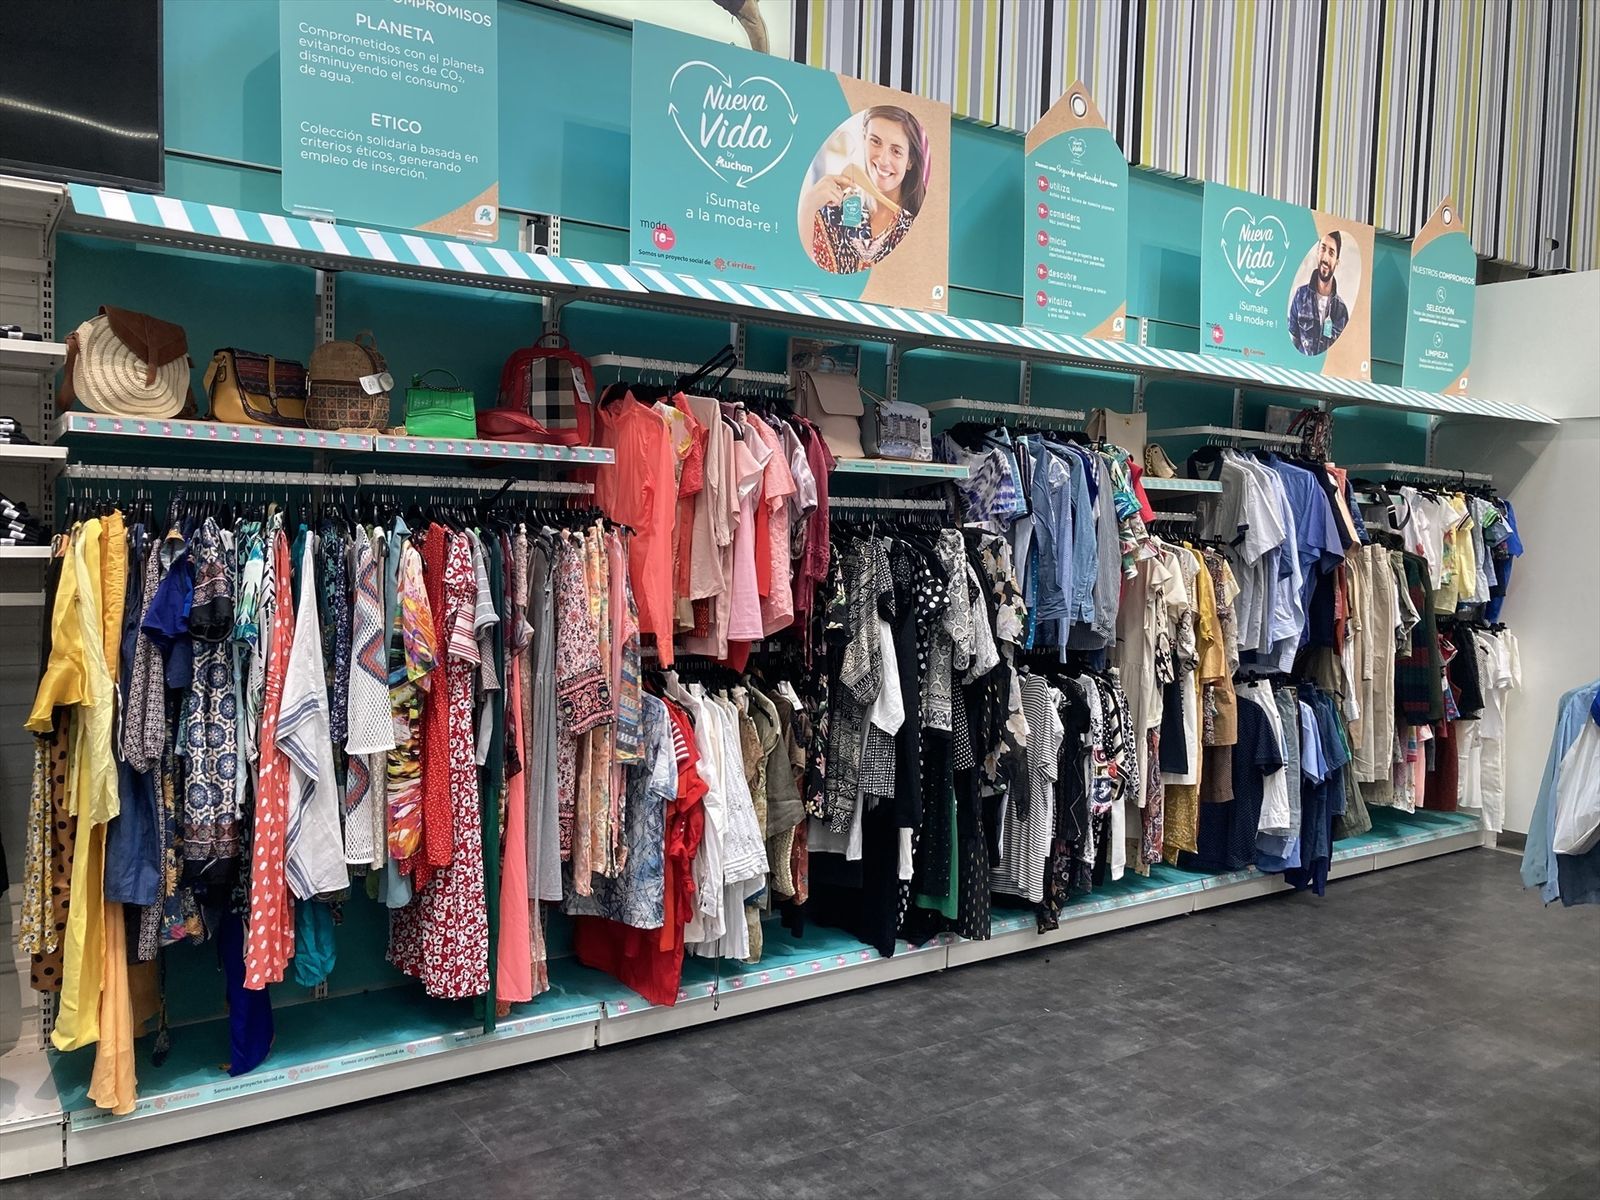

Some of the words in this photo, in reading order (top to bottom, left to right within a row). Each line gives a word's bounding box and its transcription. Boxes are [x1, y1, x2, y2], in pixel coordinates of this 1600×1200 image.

[393, 0, 492, 27] MPROMISOS
[356, 13, 434, 44] PLANETA
[299, 22, 400, 54] Comprometidos
[404, 48, 426, 60] con
[429, 54, 439, 63] el
[442, 56, 484, 75] planeta
[299, 37, 355, 57] evitando
[359, 51, 419, 72] emisiones
[422, 64, 437, 76] de
[299, 50, 388, 78] disminuyendo
[391, 71, 401, 81] el
[405, 74, 458, 94] consumo
[299, 63, 316, 76] de
[320, 68, 355, 84] agua.
[703, 84, 768, 111] Nueva
[371, 112, 422, 135] ETICO
[700, 112, 772, 148] Vida
[300, 120, 363, 143] Colección
[366, 134, 417, 153] solidaria
[421, 143, 461, 161] basada
[464, 153, 479, 163] en
[300, 135, 353, 154] criterios
[356, 145, 396, 162] éticos,
[399, 153, 462, 173] generando
[715, 155, 753, 173] Auchan
[726, 150, 735, 159] by
[300, 150, 349, 166] empleo
[352, 158, 368, 170] de
[371, 161, 428, 180] inserción.
[1049, 182, 1071, 194] utiliza
[640, 219, 668, 231] moda
[685, 208, 694, 219] a
[698, 207, 710, 221] la
[714, 213, 771, 232] moda-re
[1049, 209, 1080, 223] considera
[1239, 224, 1274, 242] Nueva
[638, 248, 657, 257] Somos
[665, 253, 688, 262] proyecto
[1237, 242, 1275, 270] Vida
[1048, 269, 1077, 282] descubre
[1412, 265, 1438, 278] NUESTROS
[1439, 271, 1475, 285] COMPROMISOS
[1048, 296, 1073, 308] vitaliza
[1426, 303, 1455, 315] SELECCIÓN
[1235, 312, 1242, 322] la
[1425, 349, 1449, 359] LIMPIEZA
[213, 1085, 232, 1094] Somos
